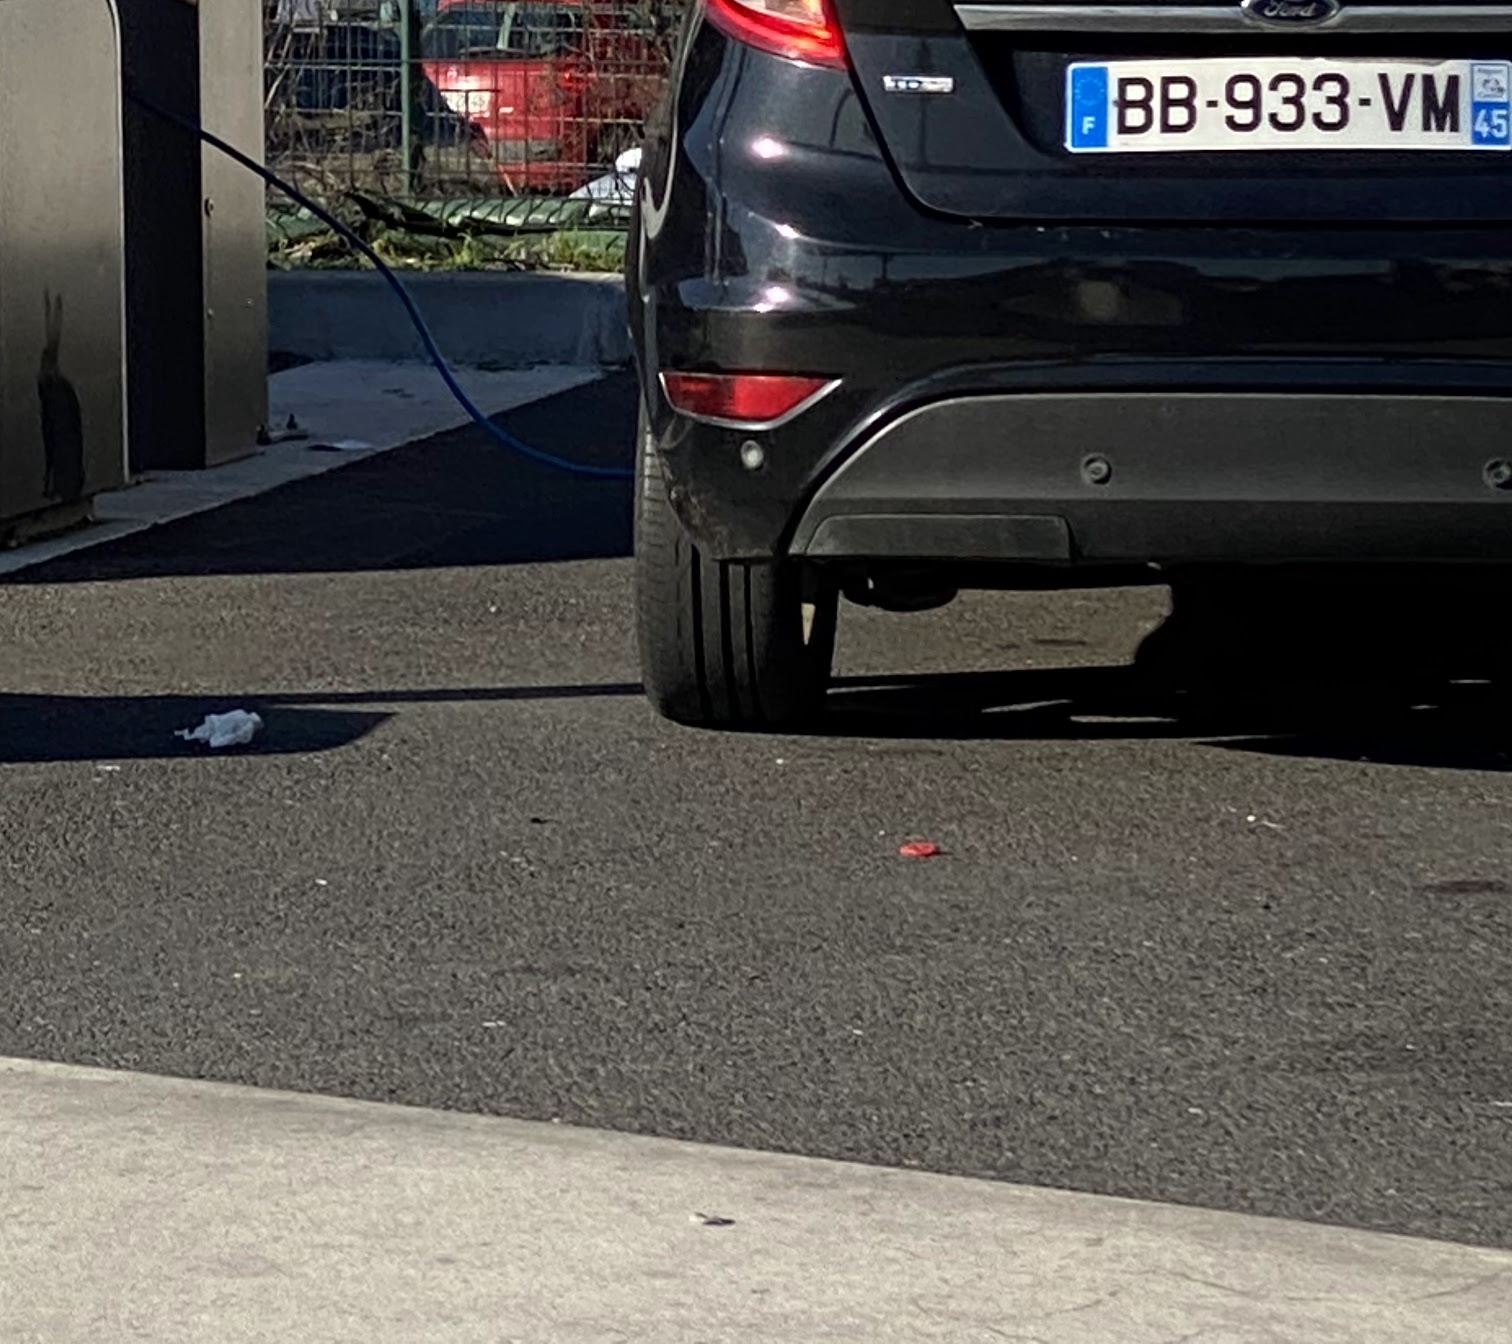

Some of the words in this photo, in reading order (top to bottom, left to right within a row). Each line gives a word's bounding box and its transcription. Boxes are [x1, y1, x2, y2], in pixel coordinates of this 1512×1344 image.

[1117, 72, 1461, 135] BB-933-VM
[1081, 116, 1096, 135] F
[1474, 109, 1508, 139] 45
